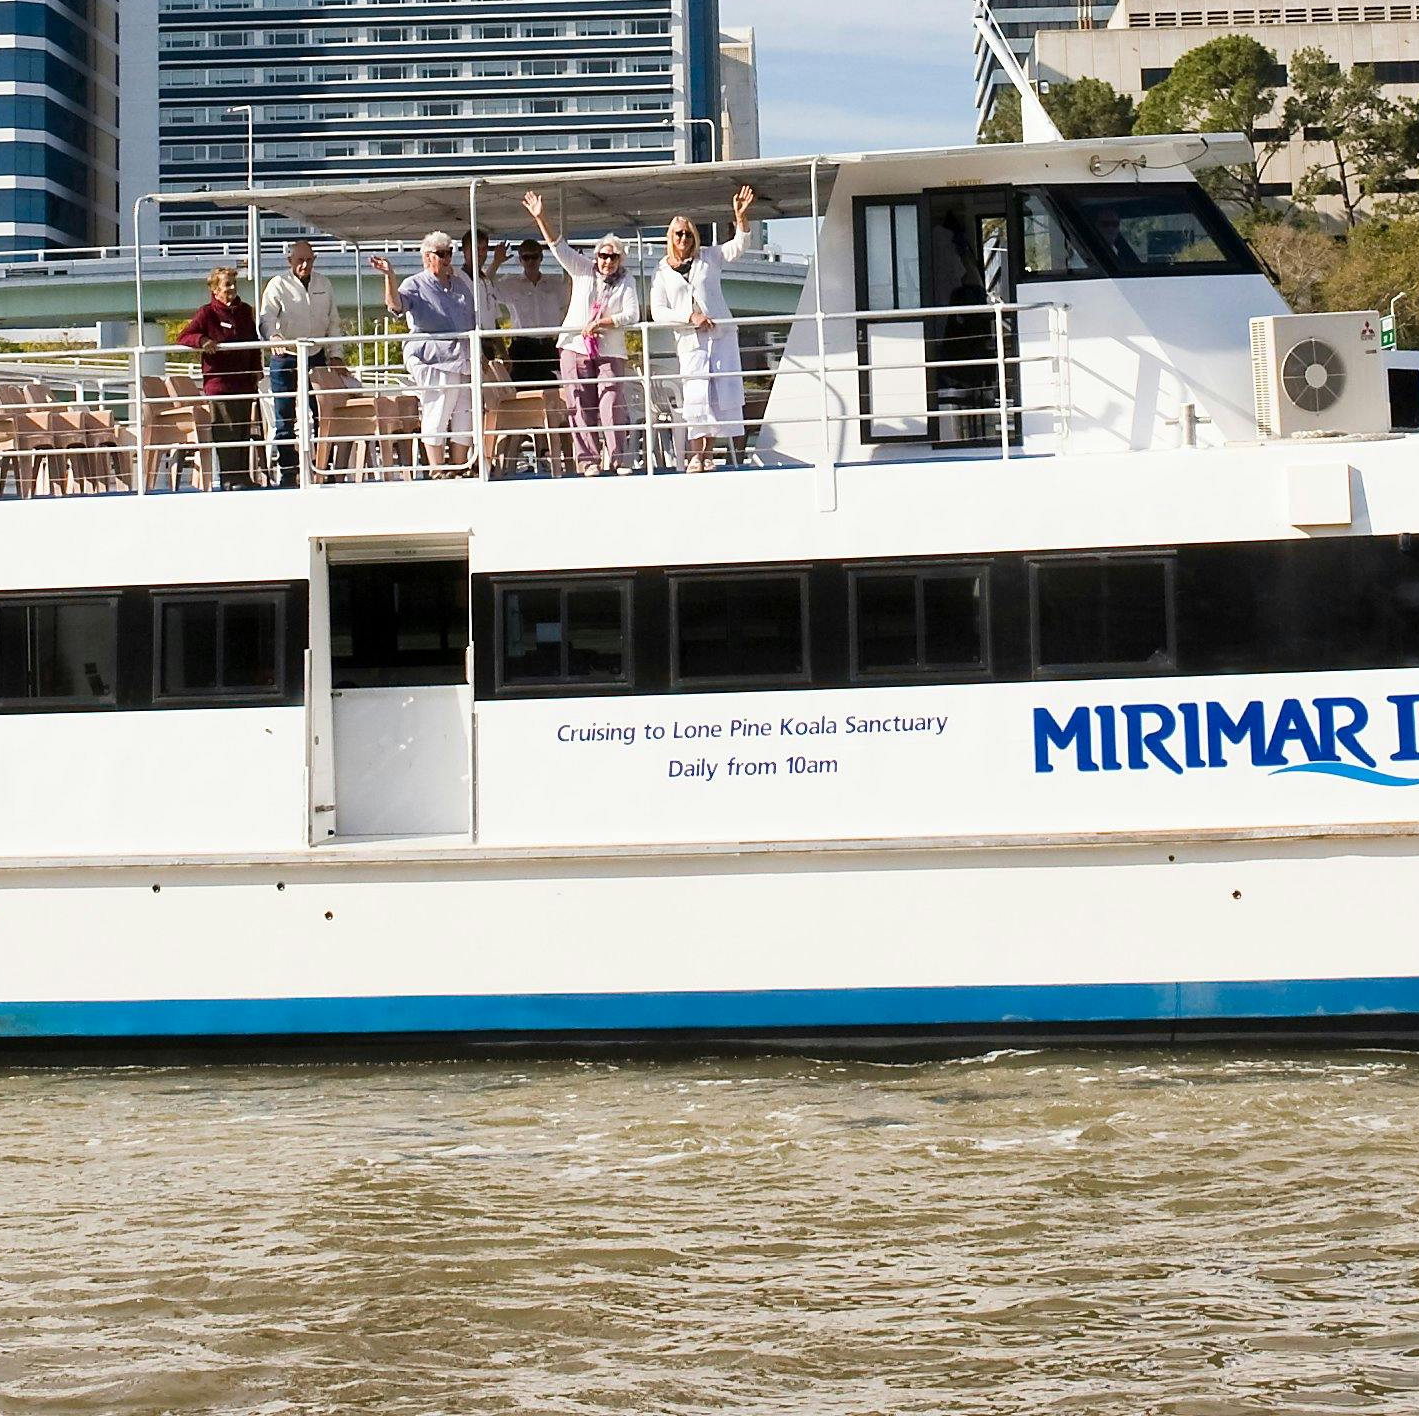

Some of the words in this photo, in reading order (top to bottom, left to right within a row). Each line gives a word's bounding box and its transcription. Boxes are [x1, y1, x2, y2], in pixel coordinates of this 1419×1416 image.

[557, 722, 636, 745] Cruising
[644, 724, 666, 740] to
[673, 721, 723, 739] Lone
[730, 718, 772, 737] Pine
[780, 715, 837, 736] Koala
[845, 715, 949, 735] Sanctuary
[1033, 696, 1377, 774] MIRIMAR
[668, 758, 719, 782] Daily
[727, 757, 777, 776] from
[786, 756, 838, 774] 10am
